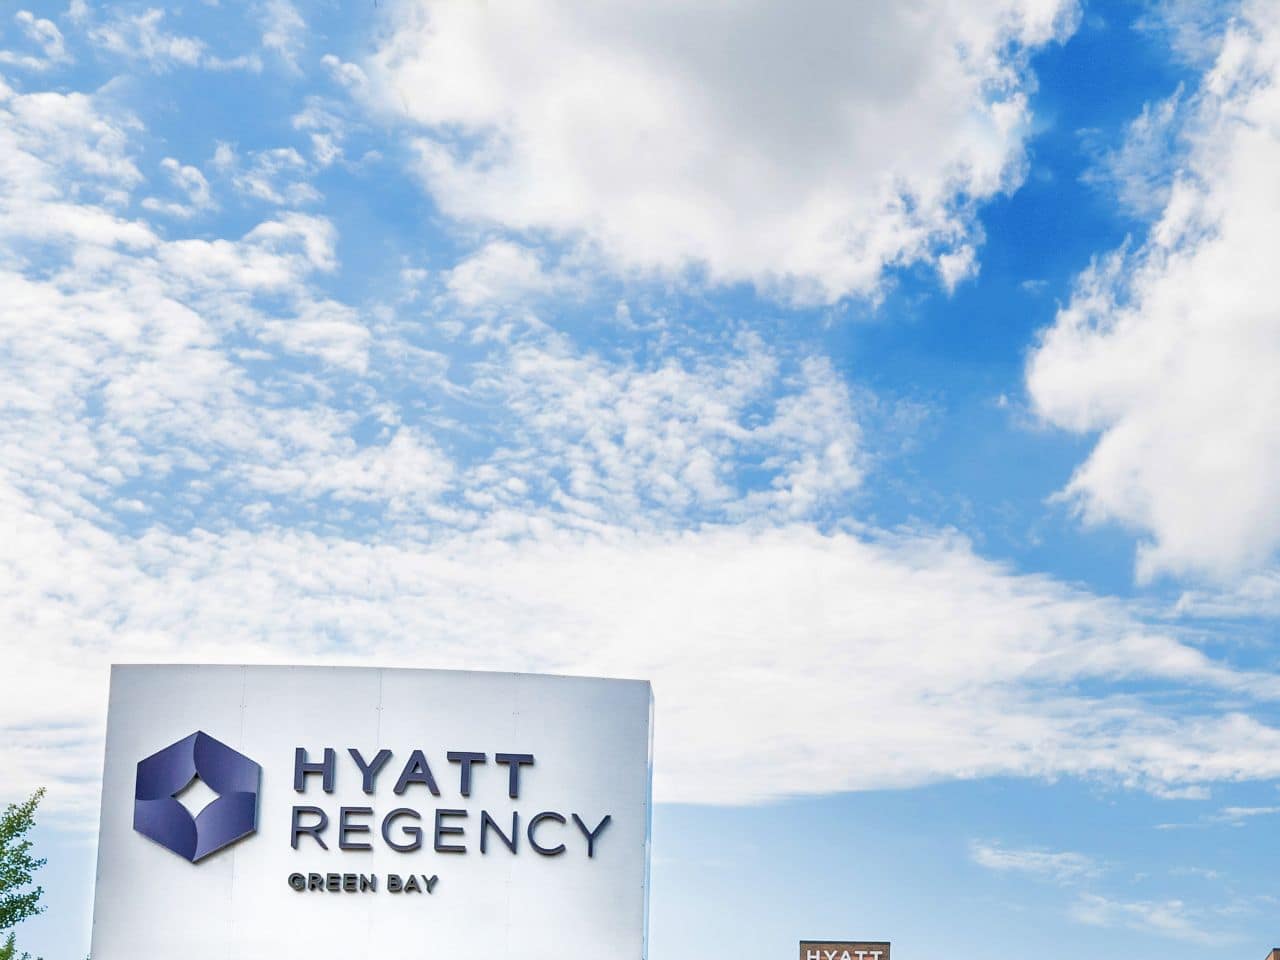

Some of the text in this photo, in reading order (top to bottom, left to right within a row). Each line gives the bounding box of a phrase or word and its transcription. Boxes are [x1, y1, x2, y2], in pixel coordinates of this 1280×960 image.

[294, 747, 535, 798] HYATT
[290, 805, 611, 858] REGENCY
[287, 872, 439, 894] GREEN BAY
